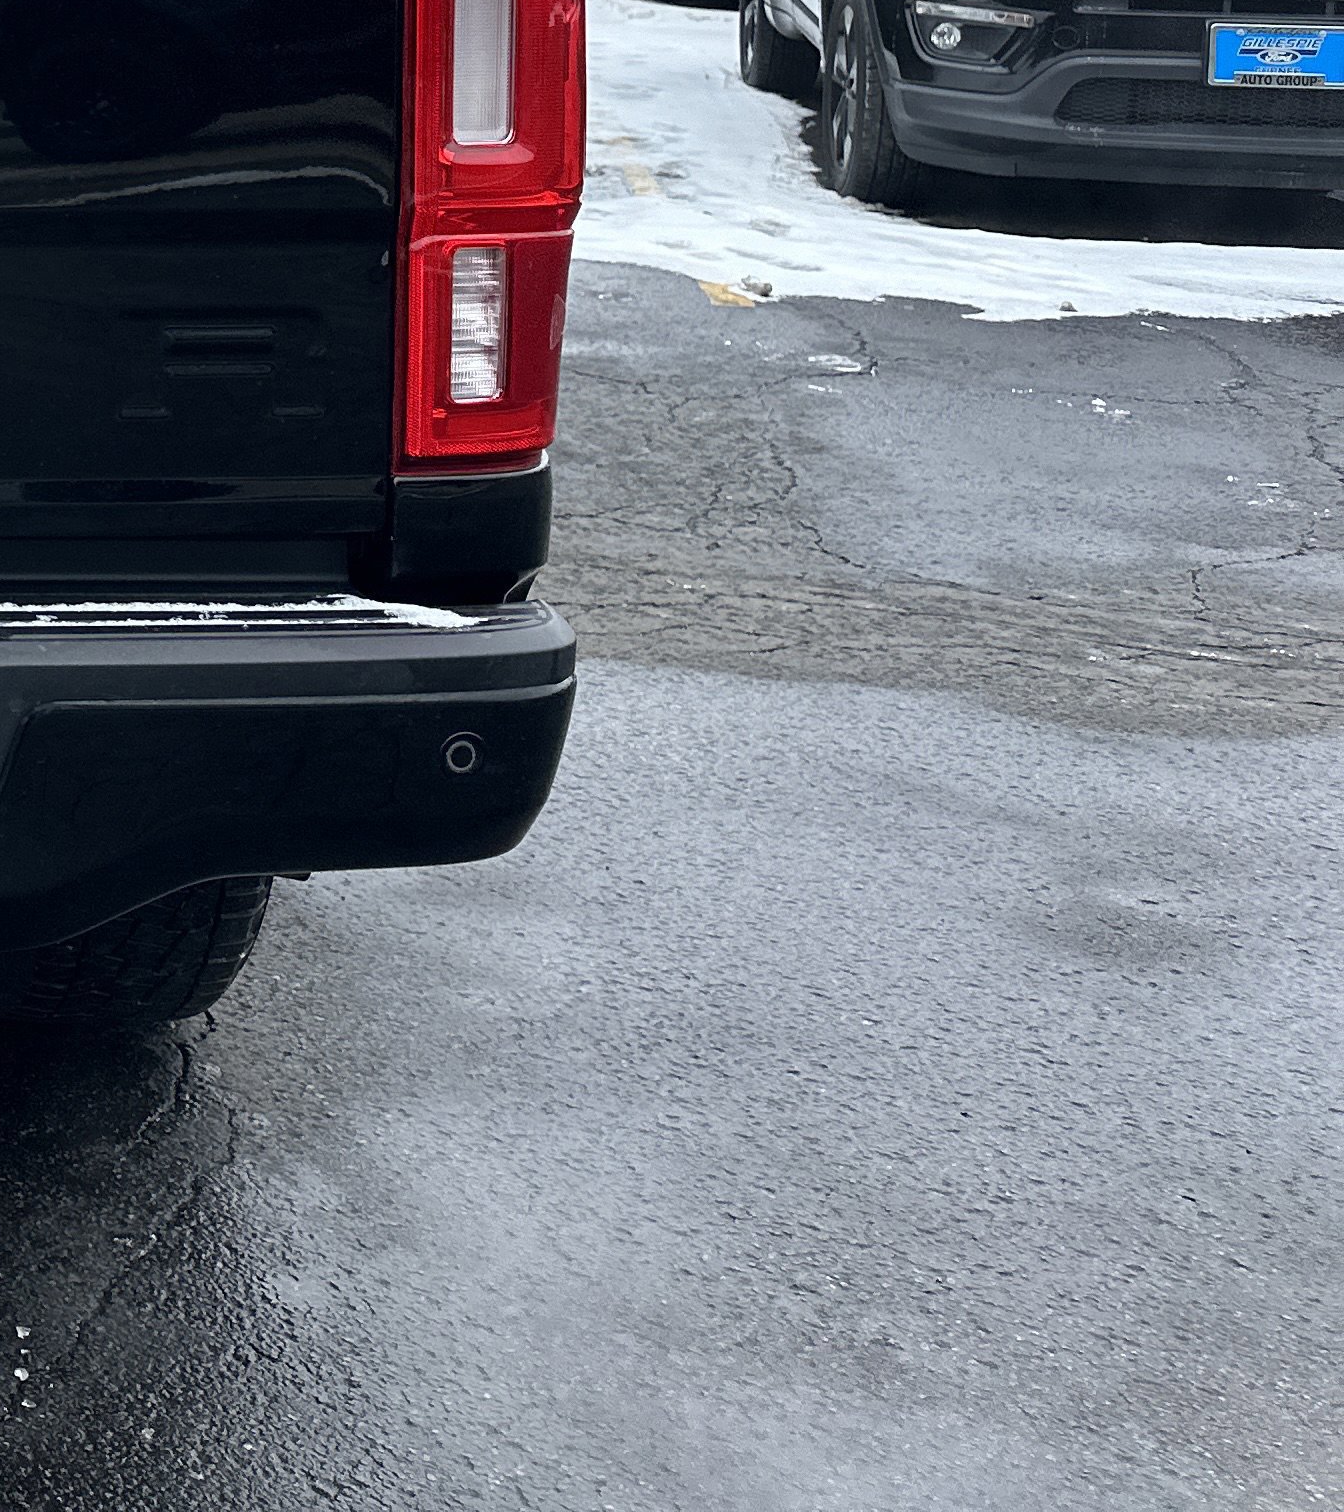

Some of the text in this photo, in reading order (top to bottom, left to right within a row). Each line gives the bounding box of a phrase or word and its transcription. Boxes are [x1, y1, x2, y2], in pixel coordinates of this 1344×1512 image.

[1241, 37, 1324, 48] GILLESPIE
[1264, 50, 1293, 62] Ford
[1240, 74, 1319, 87] AUTO GROUP
